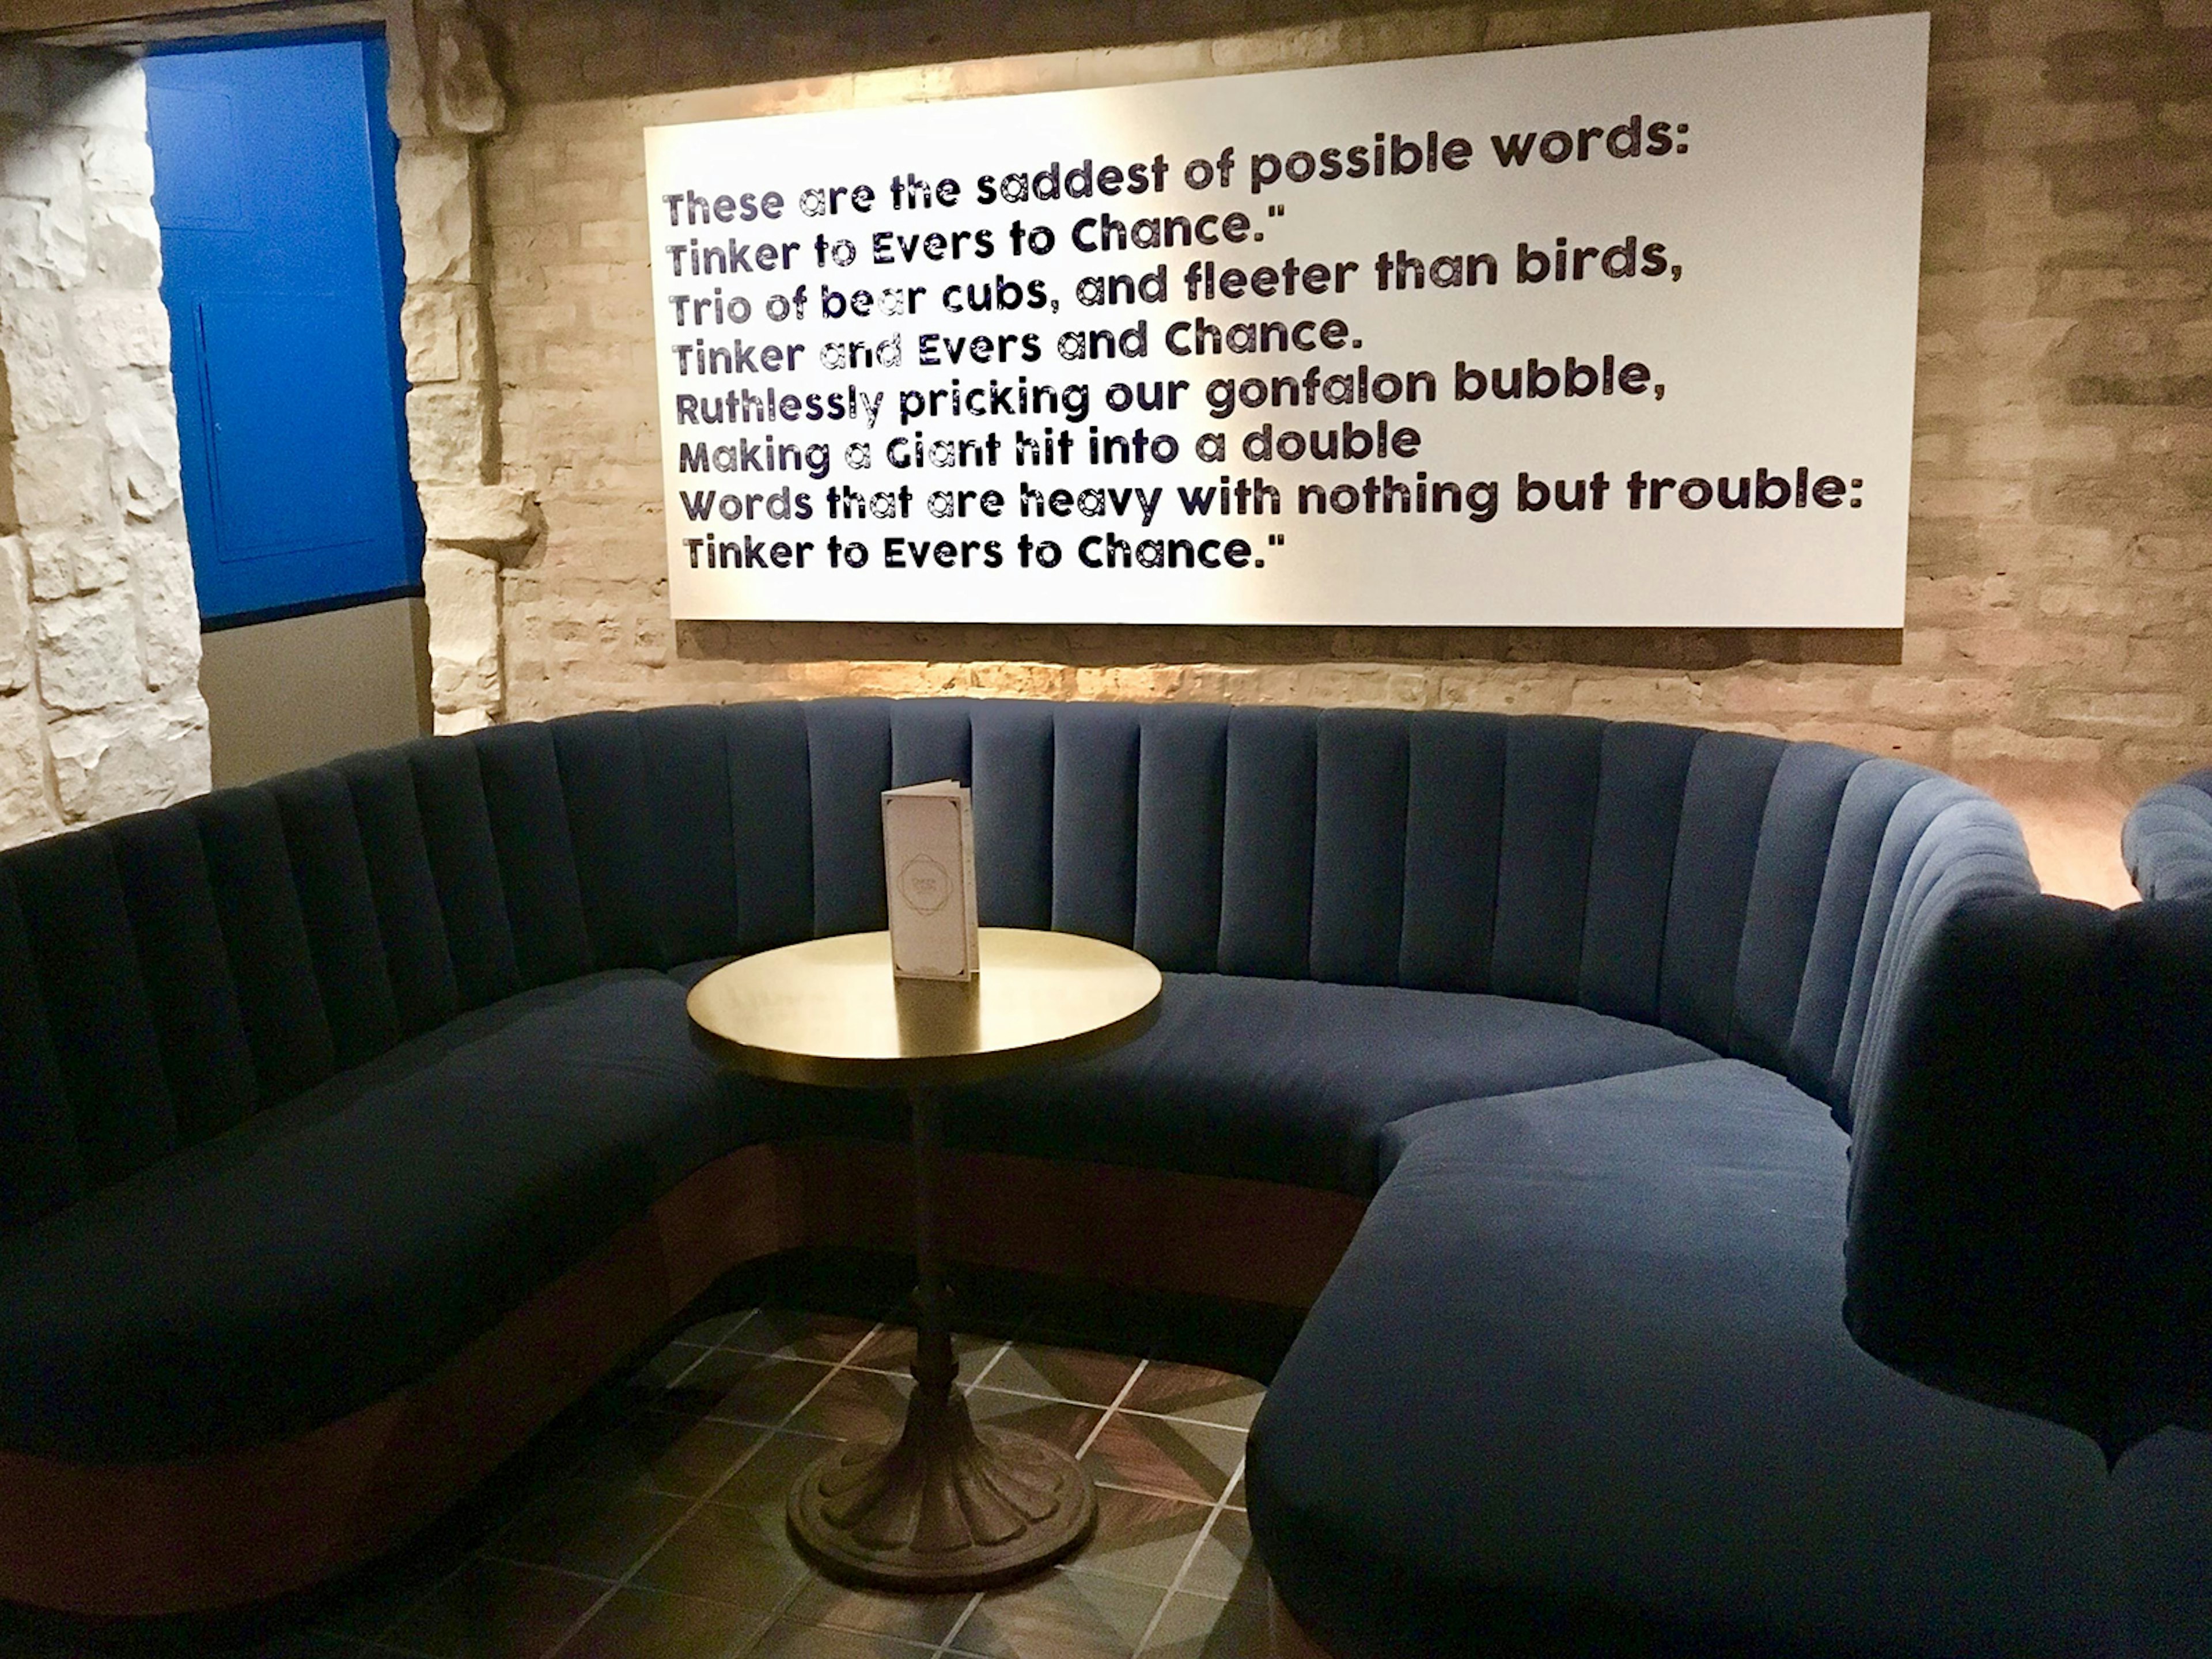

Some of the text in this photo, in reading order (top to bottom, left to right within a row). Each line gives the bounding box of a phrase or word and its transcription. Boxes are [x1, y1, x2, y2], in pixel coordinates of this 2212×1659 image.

[662, 114, 1690, 226] These are the saddest of possible words:
[665, 204, 1285, 276] Tinker to Evers to Chance."
[669, 235, 1682, 327] Trio of bear cubs, and fleeter than birds,
[672, 316, 1362, 376] Tinker and Evers and Chance.
[676, 354, 1665, 430] Ruthlessly pricking our gonfalon bubble,
[679, 419, 1421, 480] Making a Giant hit into a double
[679, 466, 1863, 527] Words that are heavy with nothing but trouble:
[683, 532, 1285, 569] Tinker to Evers to Chance."
